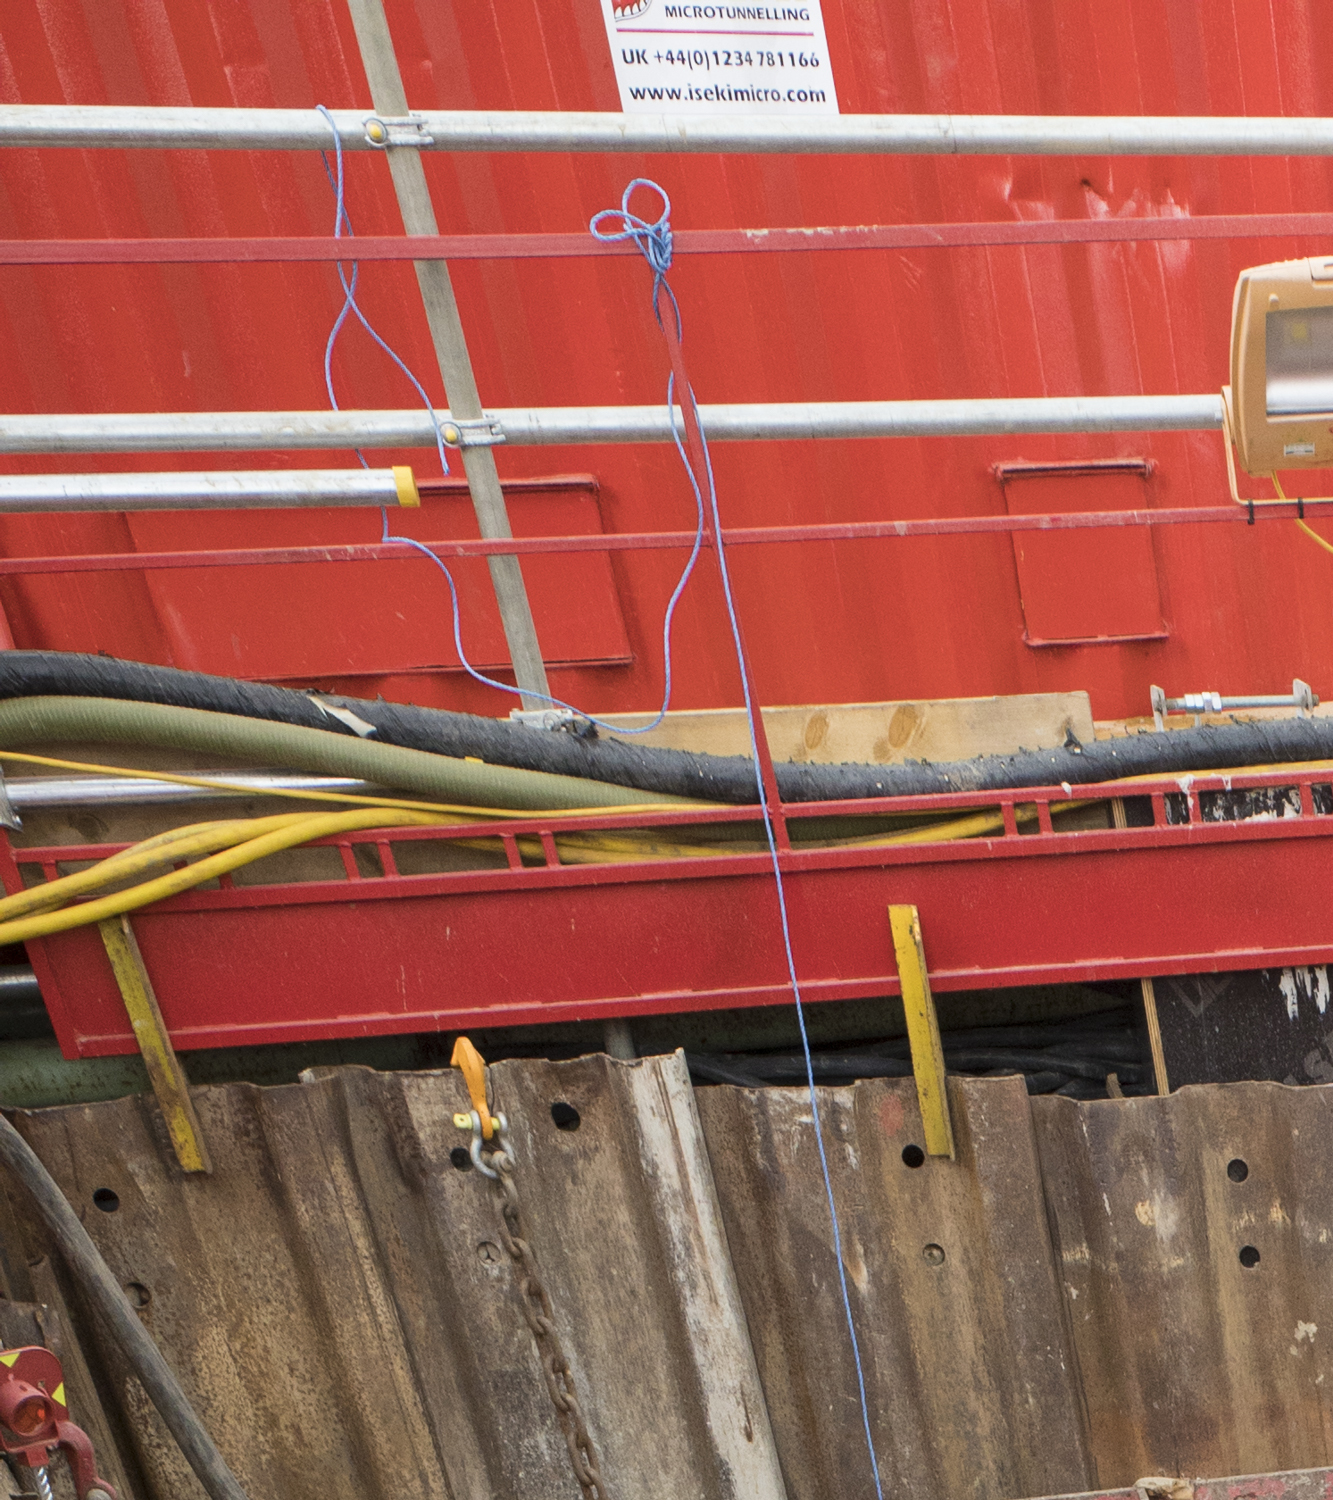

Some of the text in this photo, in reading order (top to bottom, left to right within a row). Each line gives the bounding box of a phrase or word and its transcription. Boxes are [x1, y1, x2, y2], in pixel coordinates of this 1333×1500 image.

[664, 5, 811, 21] MICROTUNNELLING
[621, 48, 648, 65] UK
[628, 83, 827, 103] www.isekimicro.com
